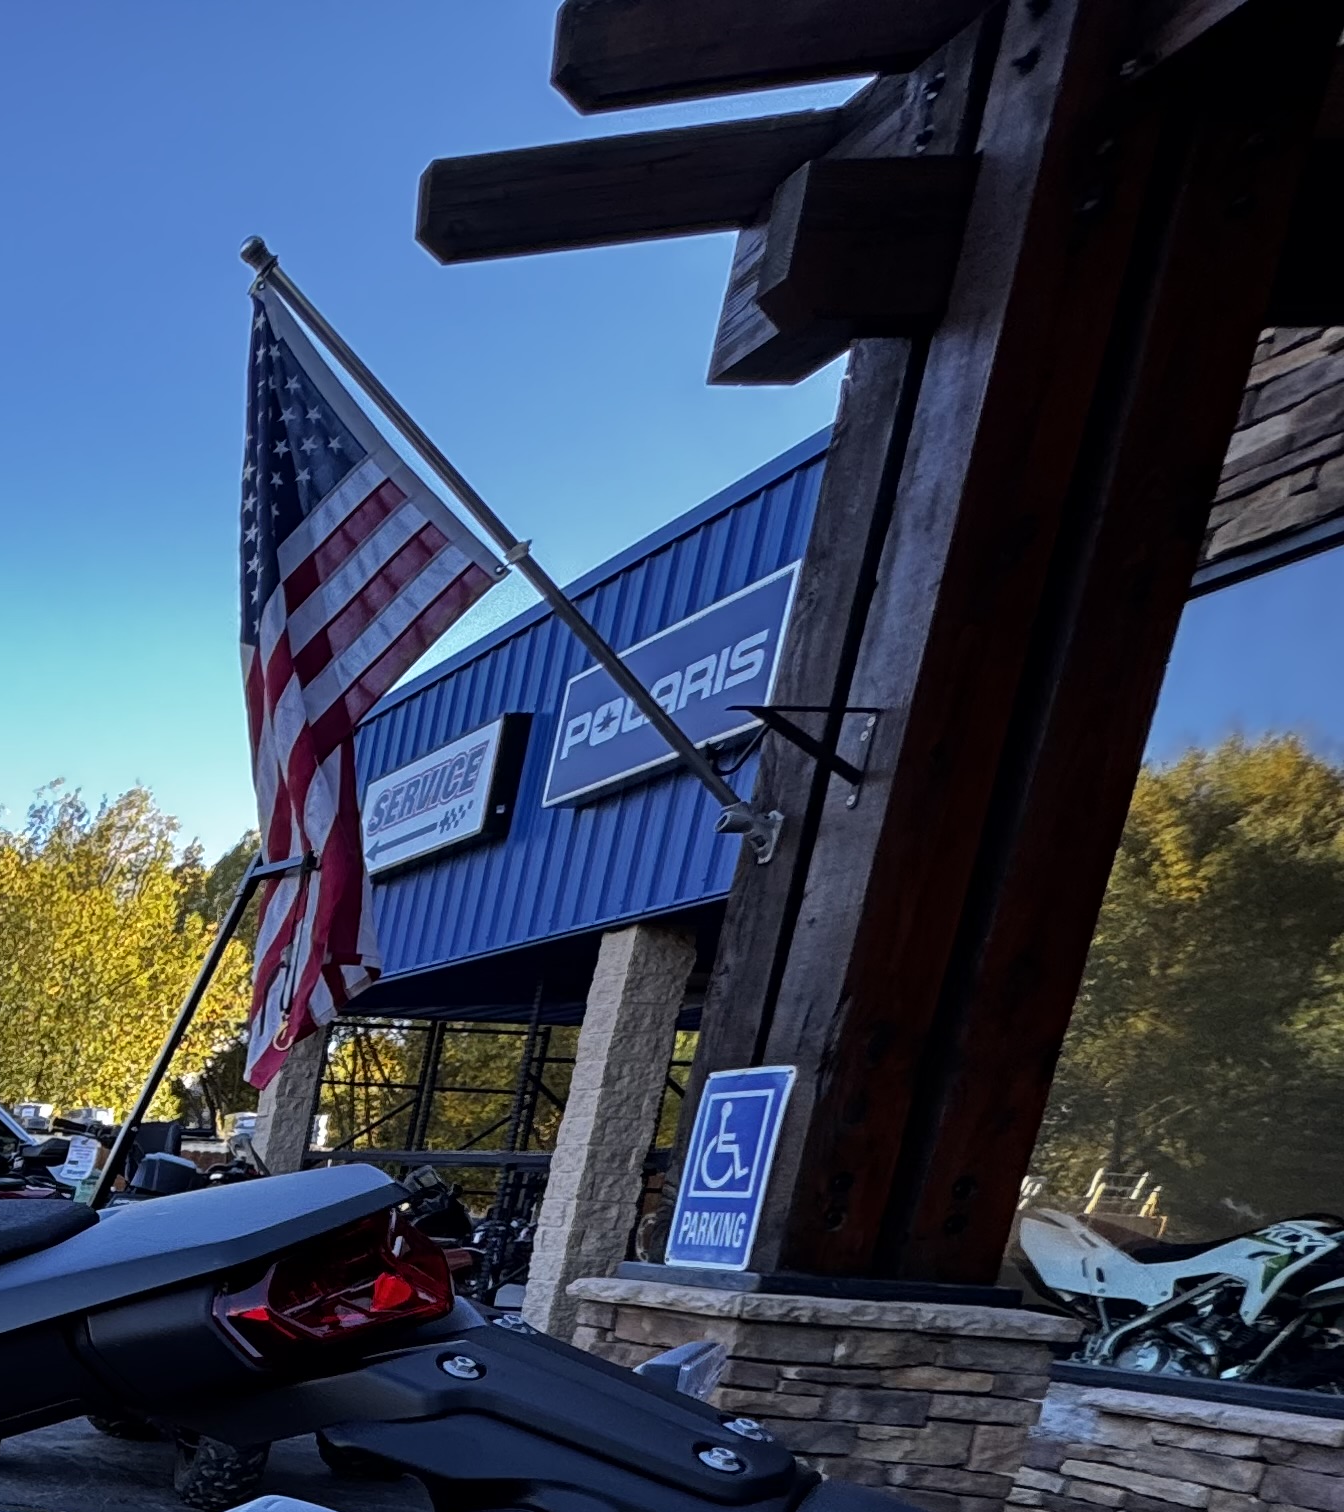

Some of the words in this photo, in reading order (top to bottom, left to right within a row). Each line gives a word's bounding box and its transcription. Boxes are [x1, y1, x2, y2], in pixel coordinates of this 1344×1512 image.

[559, 628, 770, 760] POLARIS
[366, 740, 490, 837] SERVICE
[677, 1210, 747, 1248] PARKING
